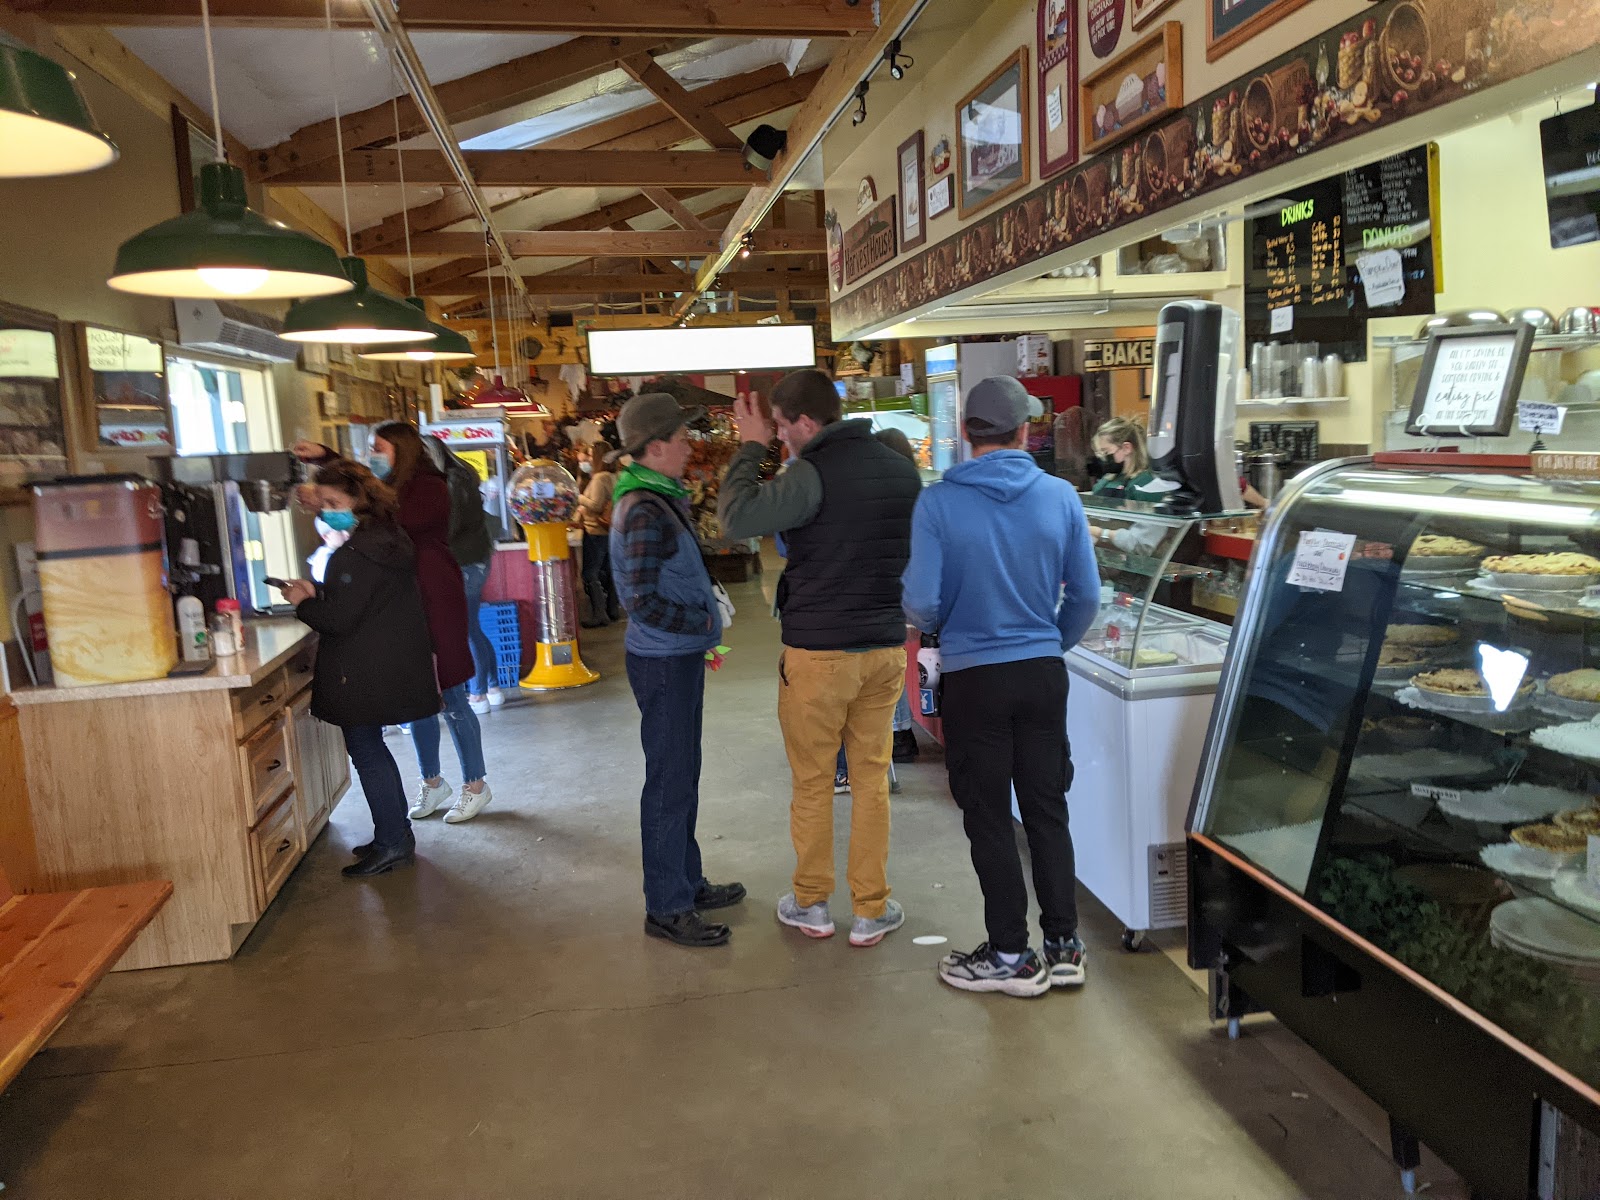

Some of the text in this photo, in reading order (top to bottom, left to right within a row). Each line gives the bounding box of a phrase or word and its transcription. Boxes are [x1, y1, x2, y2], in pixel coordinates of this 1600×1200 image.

[1281, 199, 1314, 227] DRINKS
[1362, 224, 1412, 248] DONUTS
[845, 242, 869, 279] Harvest
[869, 229, 892, 264] House
[1102, 341, 1154, 366] BAKE
[1473, 347, 1495, 358] SAYING
[1435, 382, 1497, 411] eating pie
[1574, 455, 1599, 471] HERE
